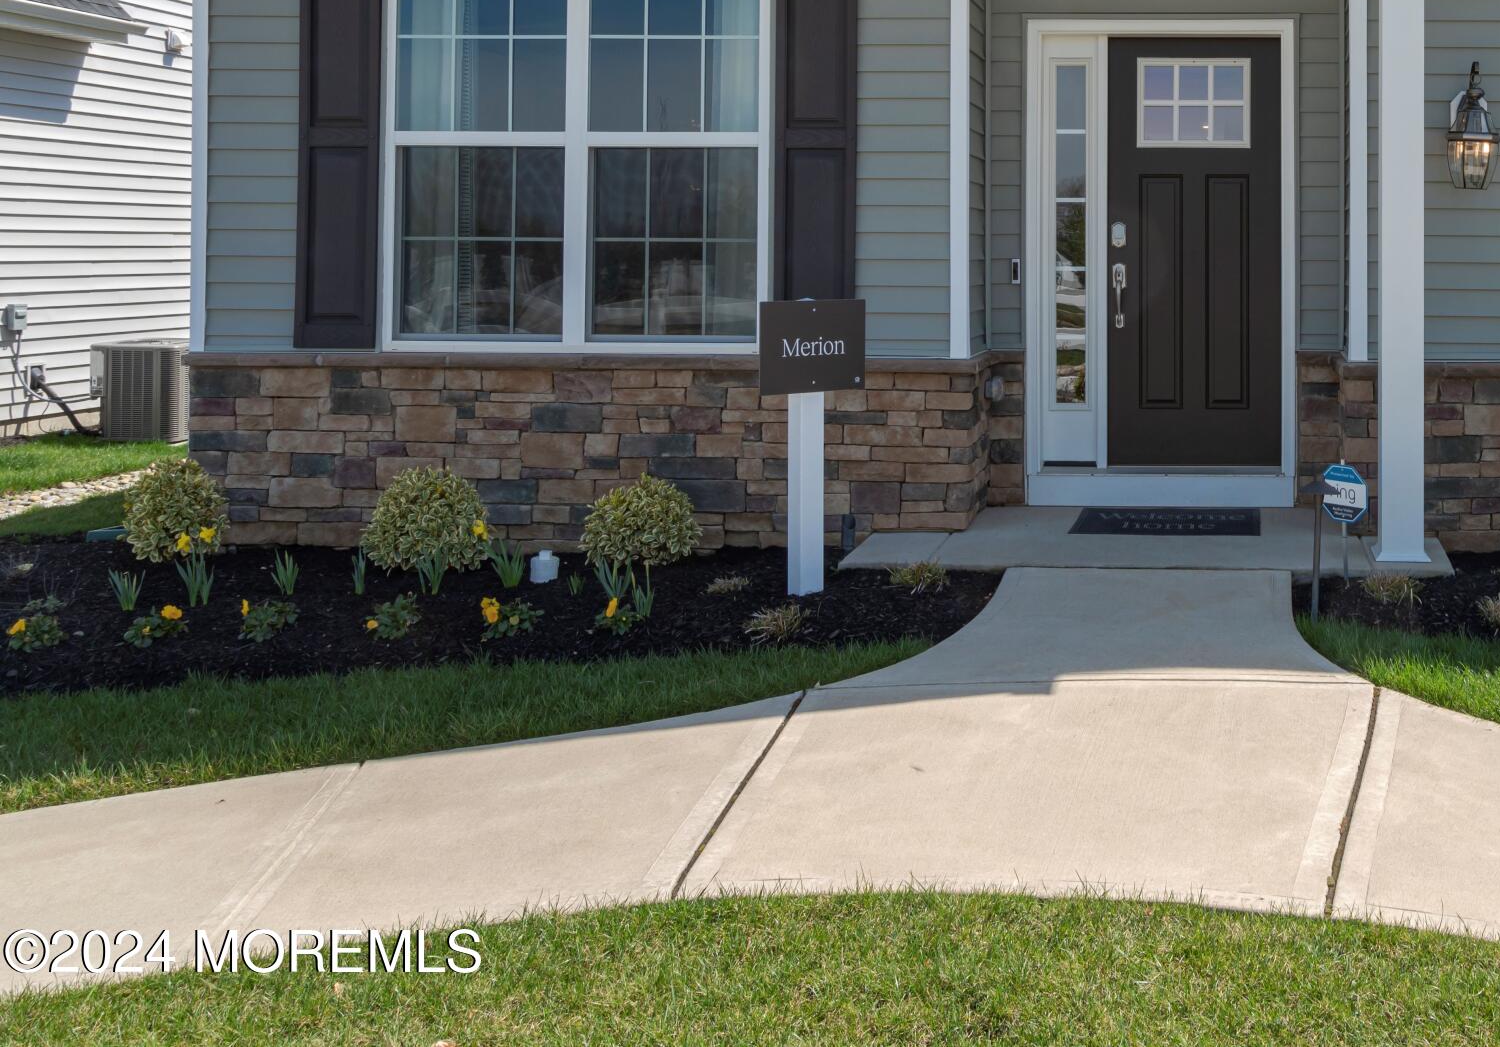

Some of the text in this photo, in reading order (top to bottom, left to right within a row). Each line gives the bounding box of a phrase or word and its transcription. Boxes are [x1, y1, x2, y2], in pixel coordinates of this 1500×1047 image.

[781, 336, 845, 357] Merion
[1331, 484, 1356, 504] ing
[1121, 521, 1216, 530] home
